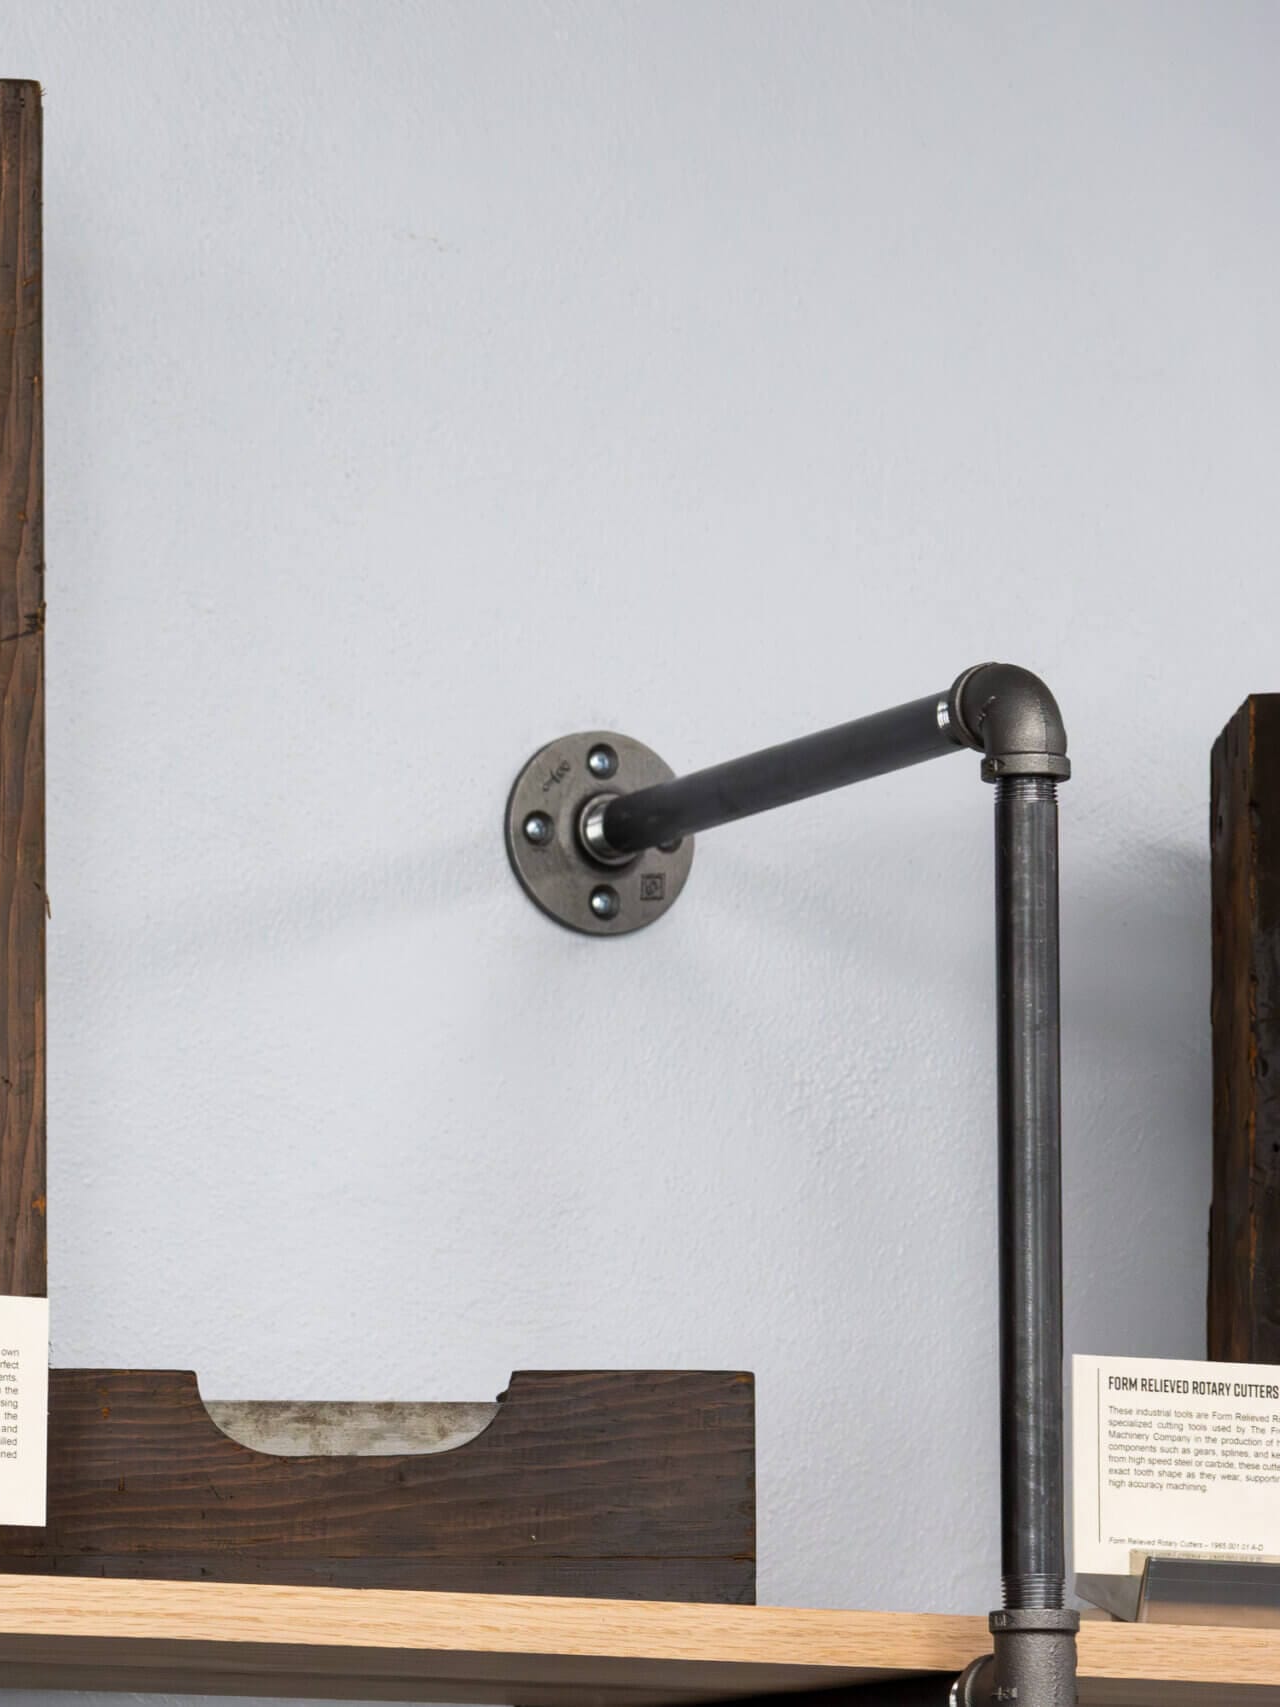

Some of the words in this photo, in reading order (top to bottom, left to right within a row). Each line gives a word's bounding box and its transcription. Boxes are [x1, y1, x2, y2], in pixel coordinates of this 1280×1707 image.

[5, 1386, 19, 1395] the
[1108, 1376, 1138, 1391] FORM
[1141, 1378, 1189, 1394] RELIEVED
[1192, 1381, 1231, 1396] ROTARY
[1234, 1383, 1279, 1399] CUTTERS
[4, 1412, 18, 1421] the
[1108, 1405, 1134, 1415] These
[1136, 1408, 1172, 1418] industrial
[1174, 1410, 1194, 1419] tools
[1212, 1411, 1233, 1420] Form
[1235, 1412, 1270, 1423] Relieved
[1, 1425, 18, 1434] and
[1108, 1420, 1152, 1428] specialized
[1157, 1422, 1184, 1432] cutting
[1212, 1425, 1232, 1433] used
[1236, 1425, 1246, 1434] by
[1250, 1426, 1266, 1434] The
[1108, 1430, 1149, 1441] Machinery
[1153, 1433, 1190, 1443] Company
[1204, 1436, 1218, 1444] the
[1221, 1438, 1262, 1446] production
[1108, 1444, 1157, 1453] components
[1254, 1451, 1269, 1459] and
[1108, 1454, 1126, 1463] from
[1128, 1456, 1146, 1465] high
[1148, 1458, 1172, 1466] speed
[1238, 1462, 1260, 1470] these
[1134, 1468, 1154, 1476] tooth
[1158, 1470, 1182, 1479] shape
[1200, 1472, 1216, 1481] they
[1108, 1479, 1126, 1489] high
[1128, 1481, 1164, 1491] accuracy
[1180, 1540, 1203, 1548] Cutters
